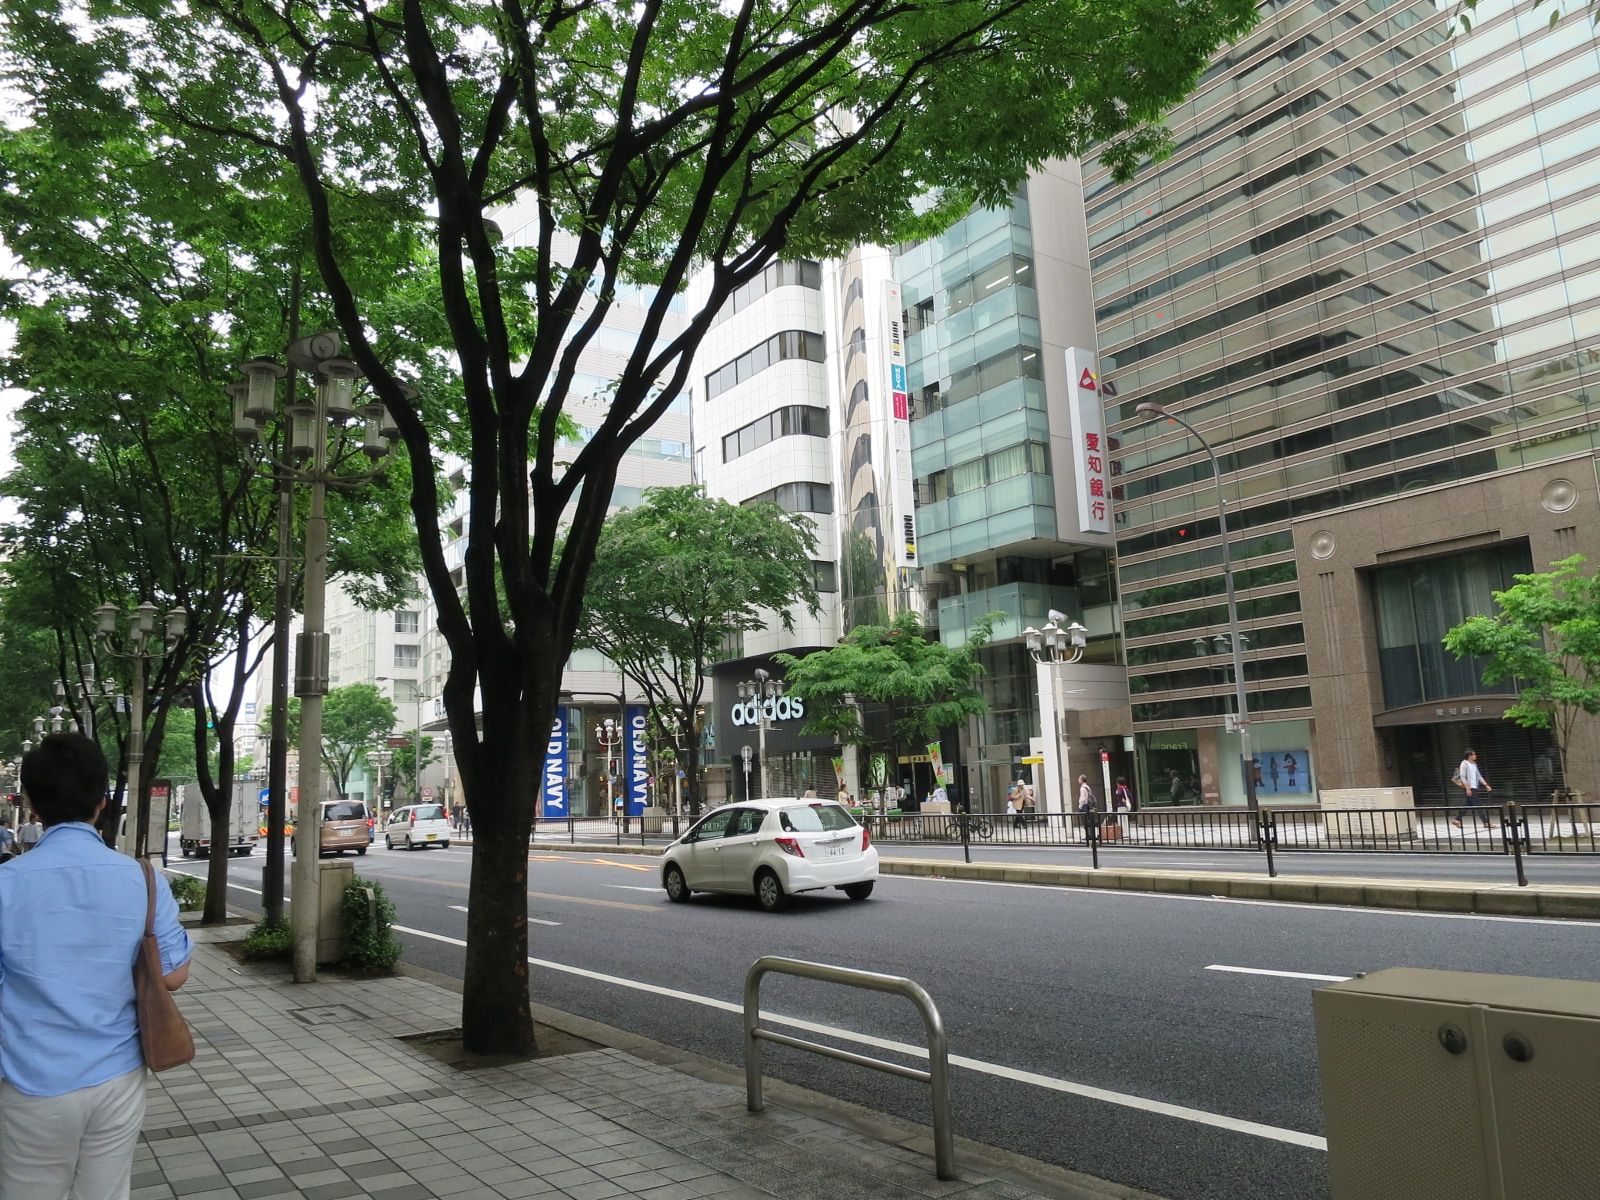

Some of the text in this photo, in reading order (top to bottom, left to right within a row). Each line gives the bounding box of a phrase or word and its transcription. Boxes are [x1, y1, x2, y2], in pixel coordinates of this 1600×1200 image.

[894, 367, 902, 389] NOVA
[1086, 433, 1104, 521] 愛知銀行
[731, 691, 804, 727] adidas
[546, 758, 563, 809] NAVY
[632, 715, 648, 806] OLD NAVY
